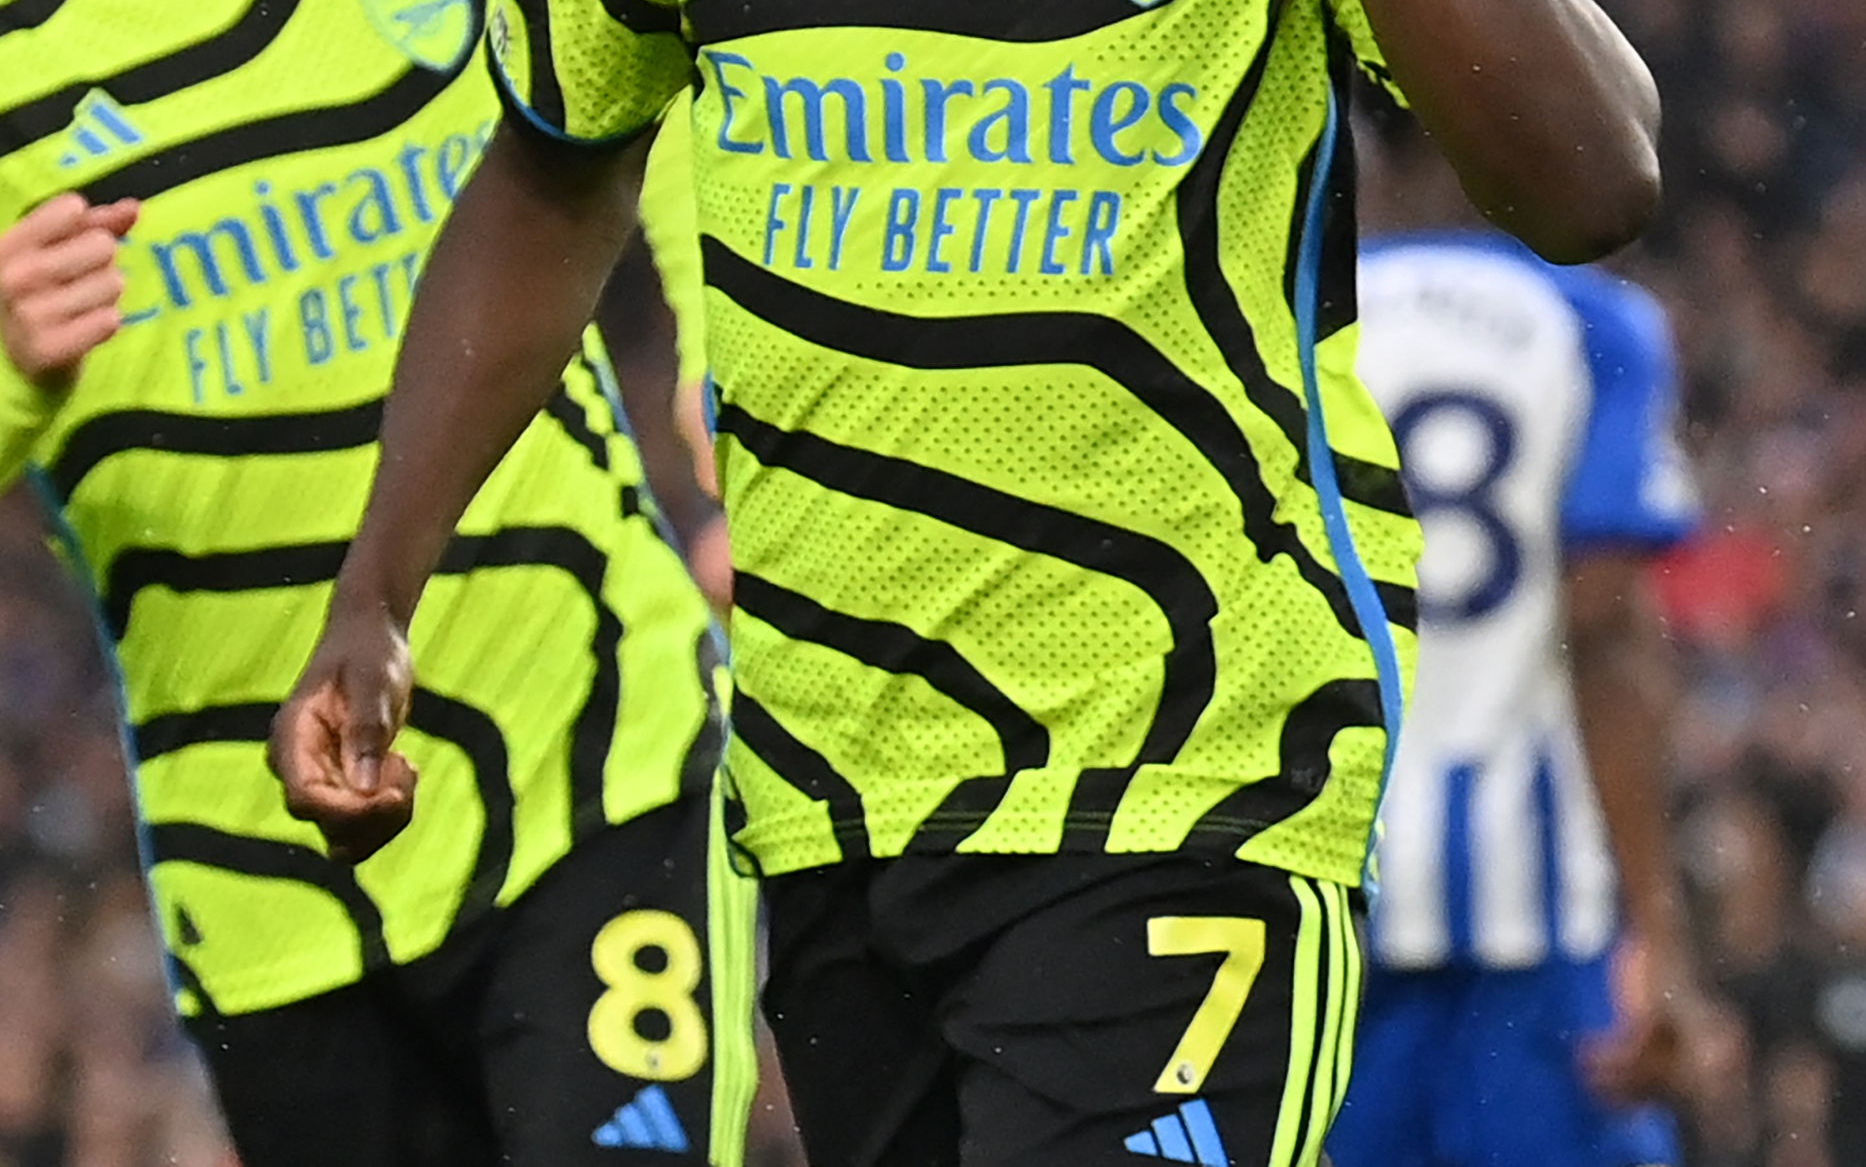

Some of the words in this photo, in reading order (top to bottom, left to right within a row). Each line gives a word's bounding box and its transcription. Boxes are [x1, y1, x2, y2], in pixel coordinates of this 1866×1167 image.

[703, 51, 1205, 167] Emirates
[120, 119, 491, 327] mirate
[764, 183, 861, 271] FLY
[881, 188, 1122, 275] BETTER
[184, 307, 272, 405] FLY
[588, 909, 708, 1081] 8
[1147, 916, 1266, 1093] 7
